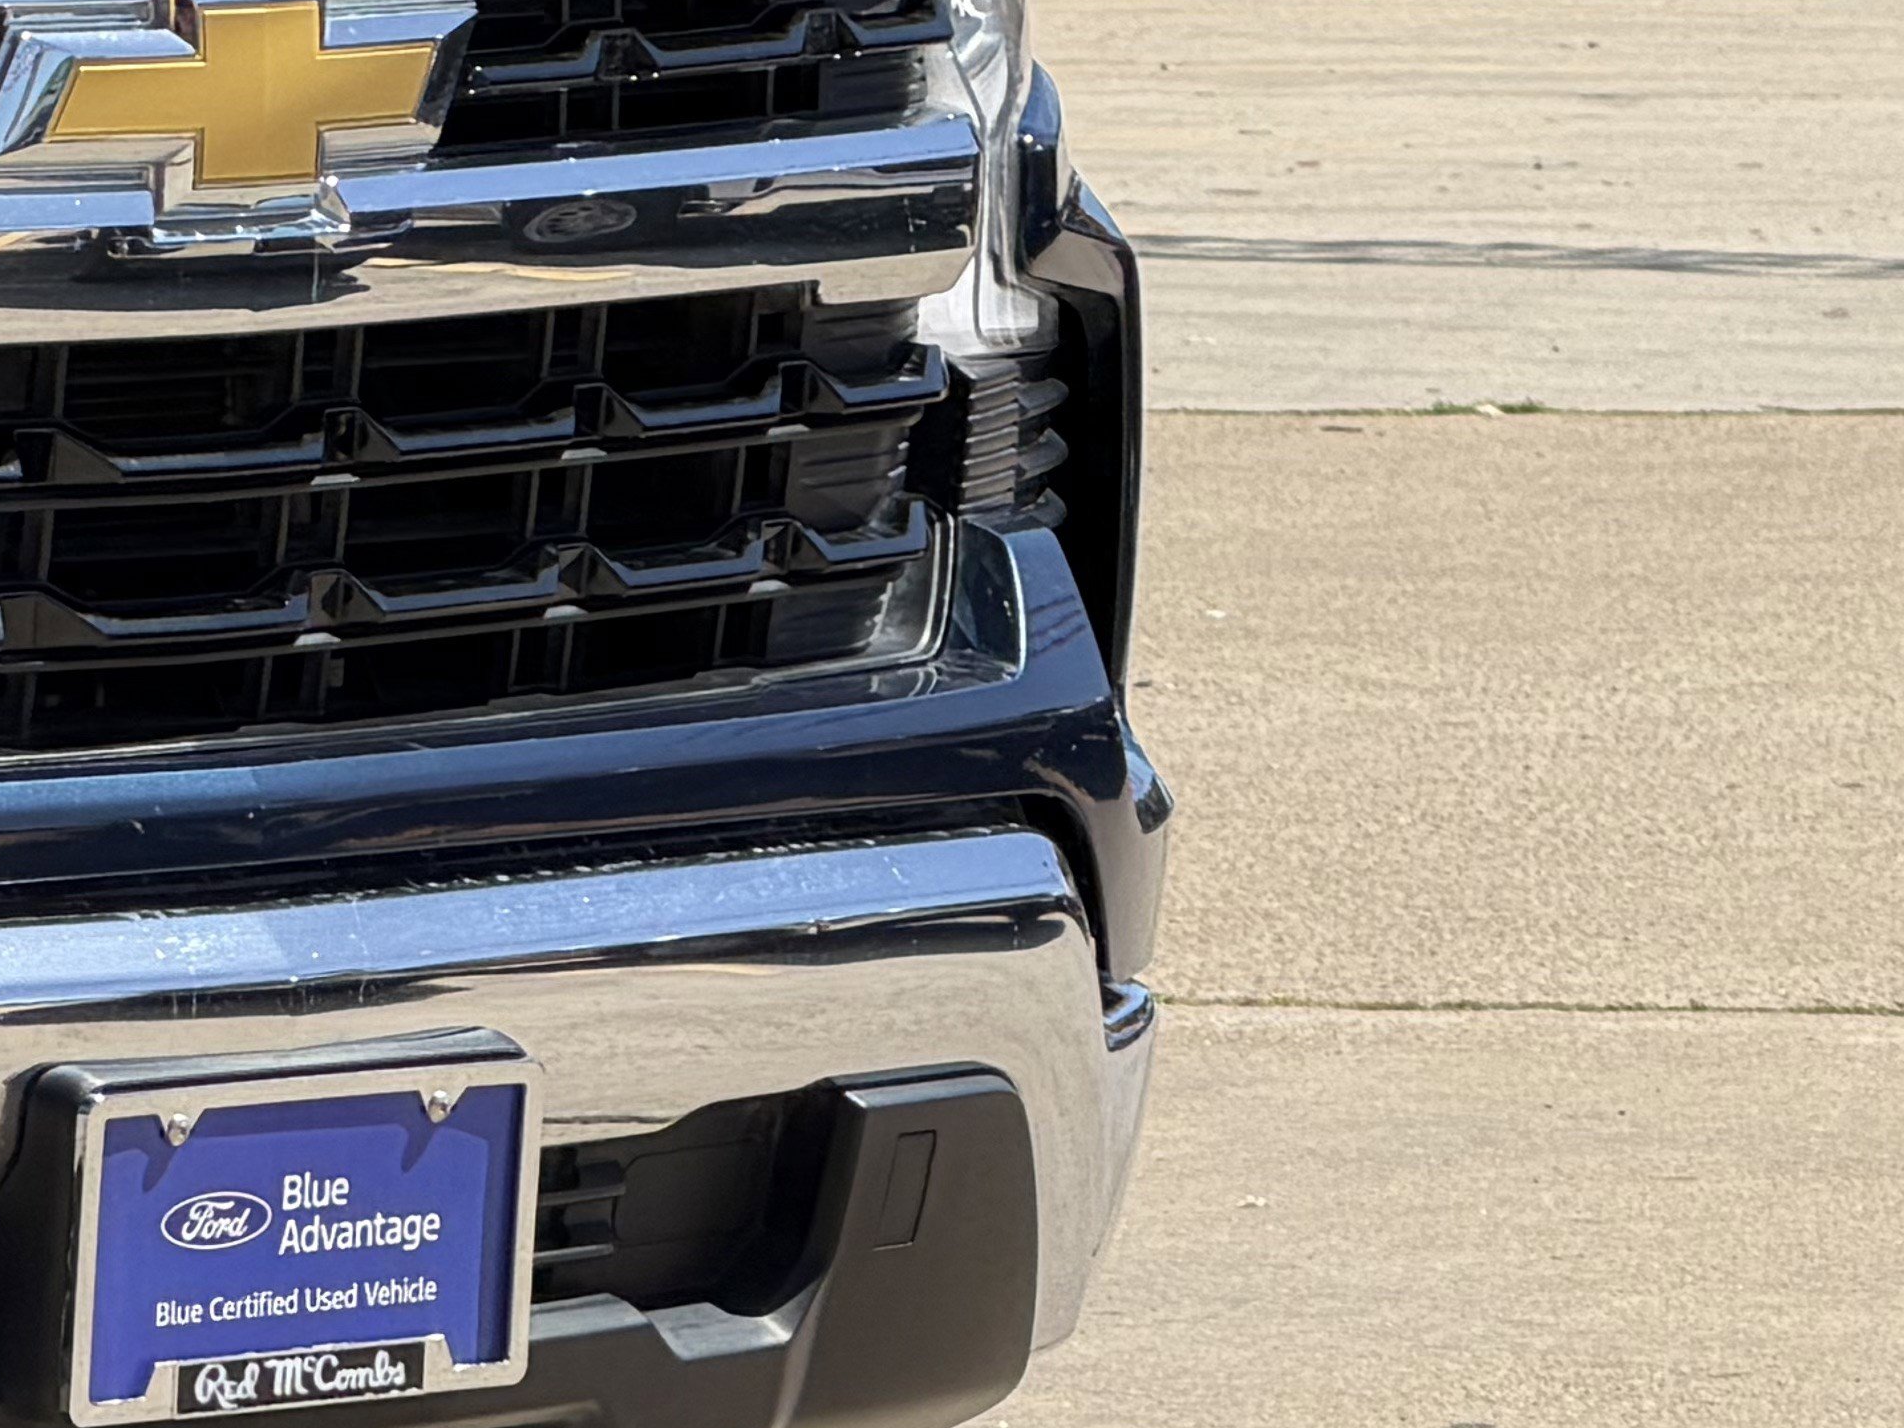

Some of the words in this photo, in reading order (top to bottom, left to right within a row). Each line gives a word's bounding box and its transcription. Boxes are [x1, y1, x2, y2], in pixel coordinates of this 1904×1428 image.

[281, 1172, 349, 1210] Blue
[180, 1200, 250, 1243] Ford
[278, 1212, 440, 1255] Advantage
[155, 1296, 204, 1328] Blue
[209, 1288, 299, 1322] Certified
[304, 1281, 359, 1311] Used
[363, 1275, 438, 1307] Vehicle
[266, 1349, 407, 1399] McCombs
